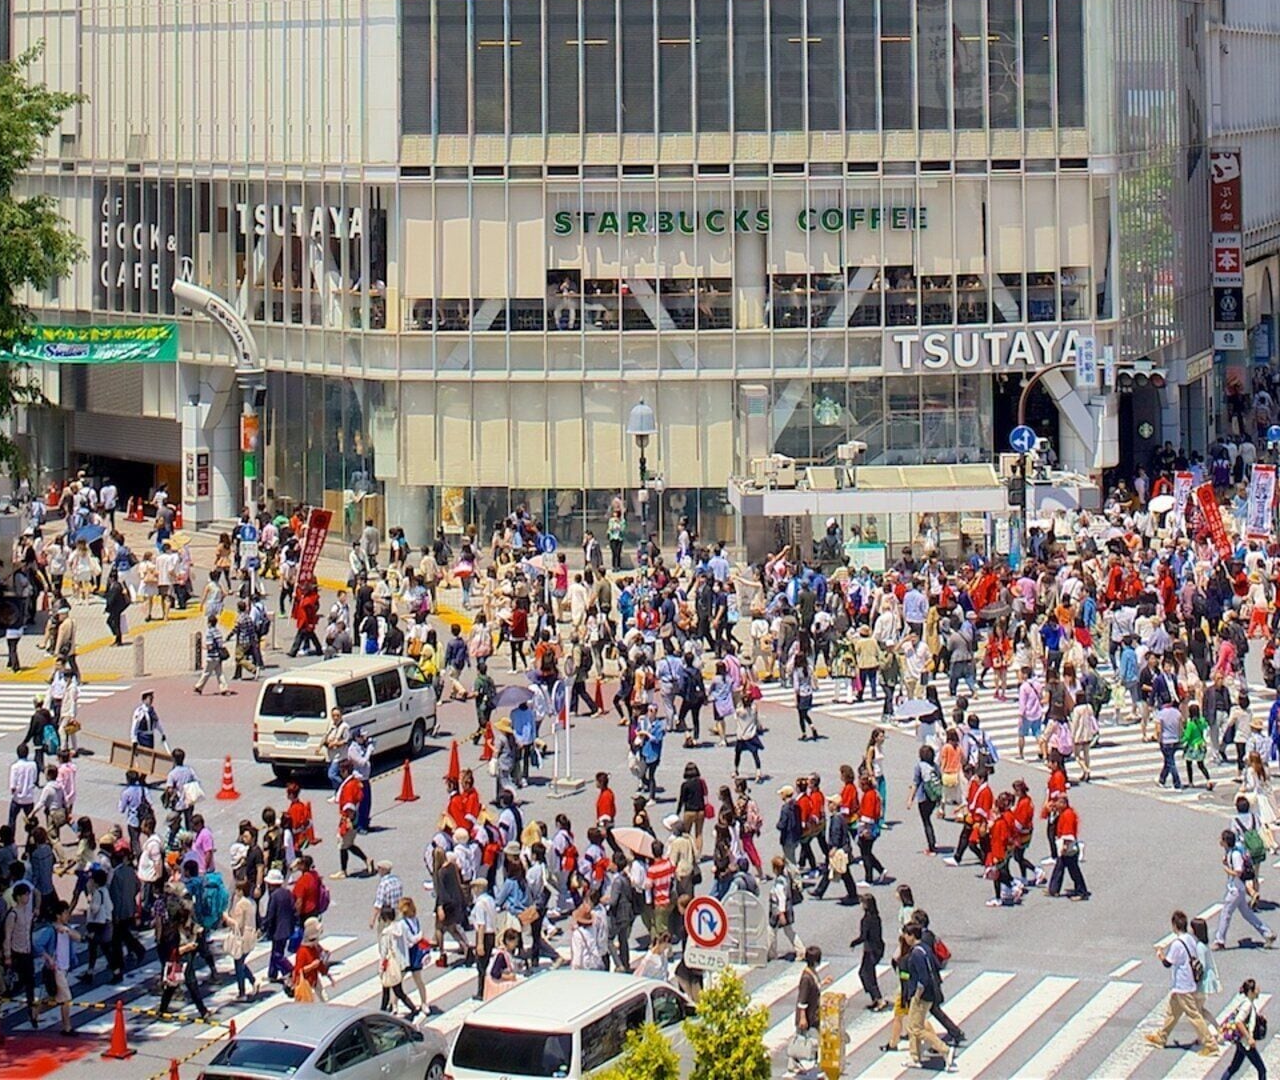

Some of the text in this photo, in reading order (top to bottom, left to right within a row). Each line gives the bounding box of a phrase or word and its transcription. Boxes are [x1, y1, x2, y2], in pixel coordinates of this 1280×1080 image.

[235, 202, 363, 238] TSUTAYA
[553, 206, 928, 235] STARBUCKS COFFEE
[1217, 250, 1238, 270] 本
[893, 329, 1080, 369] TSUTAYA
[688, 952, 726, 968] ここから
